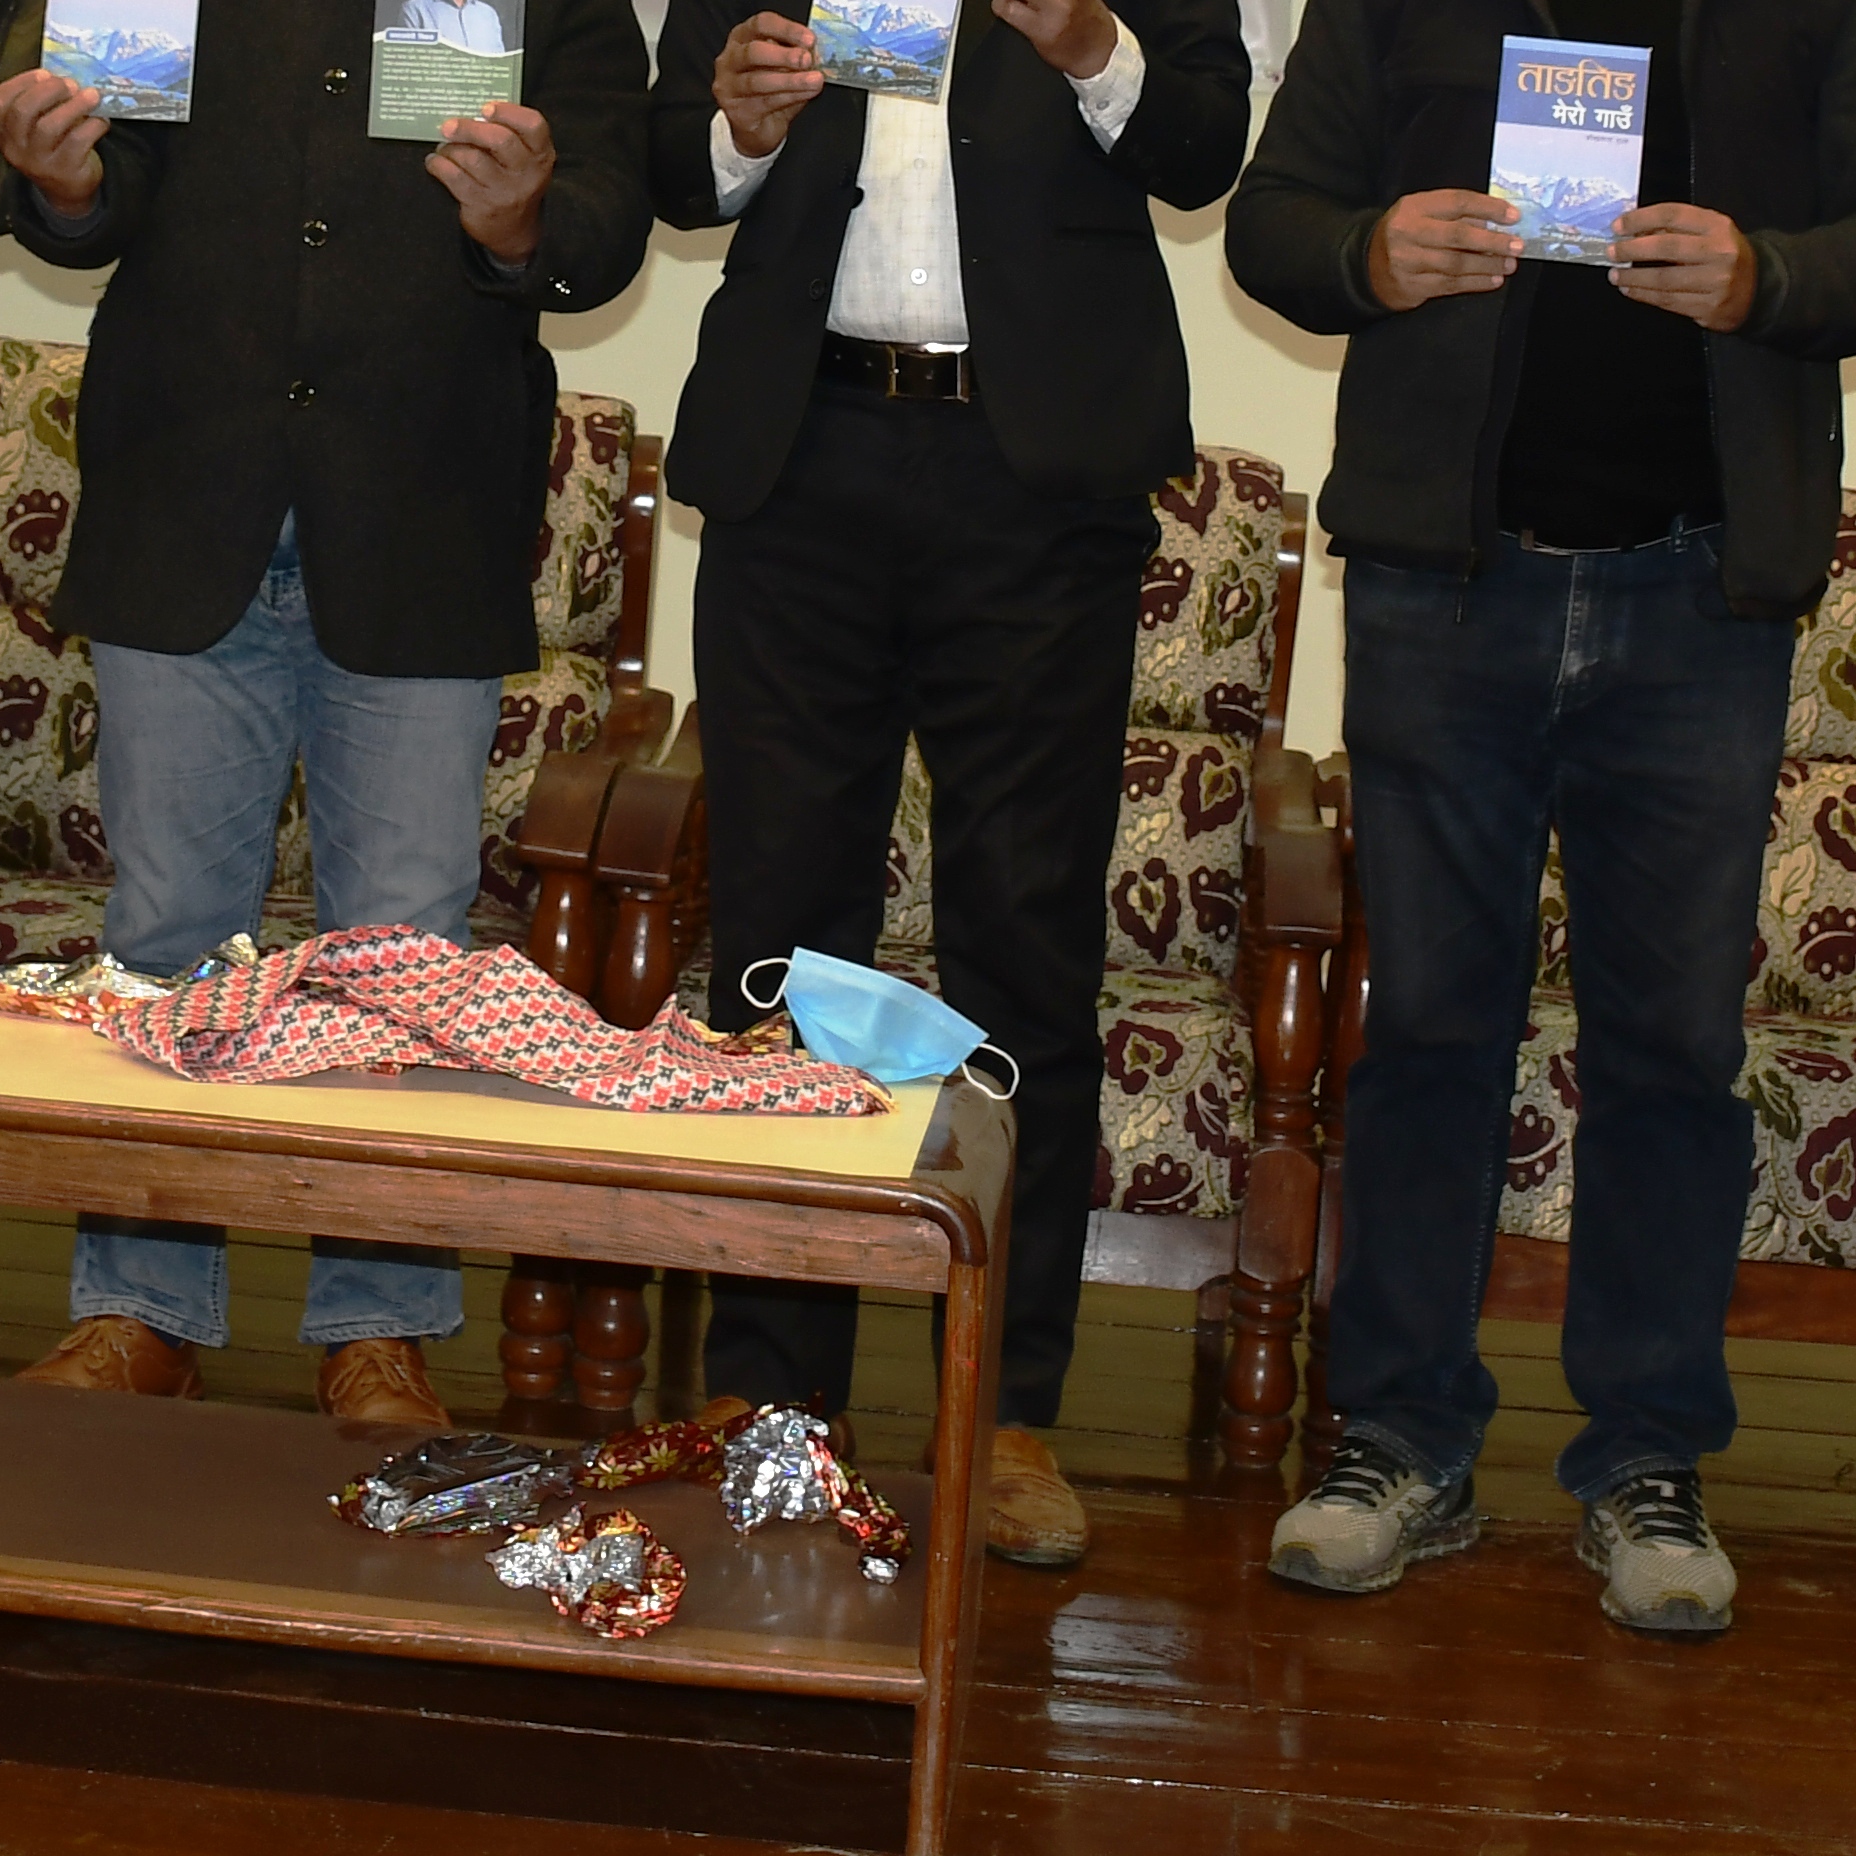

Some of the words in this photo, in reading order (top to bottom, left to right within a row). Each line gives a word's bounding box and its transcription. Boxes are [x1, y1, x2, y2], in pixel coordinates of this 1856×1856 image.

[1517, 58, 1637, 101] ताङतिङ
[1552, 98, 1587, 127] मेरो
[1594, 104, 1633, 130] गाउँ
